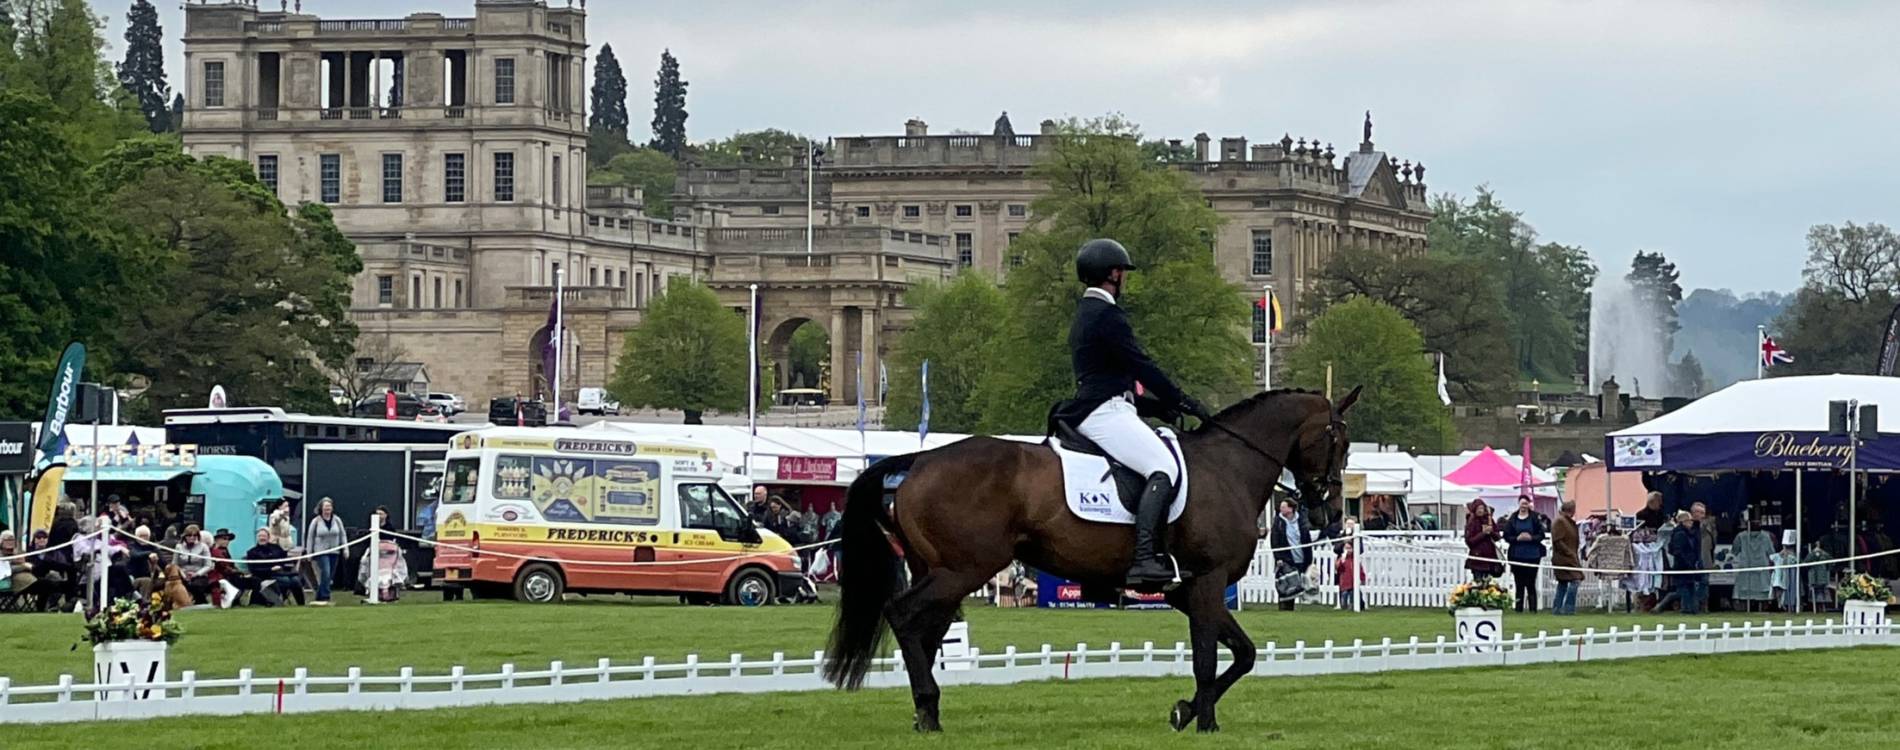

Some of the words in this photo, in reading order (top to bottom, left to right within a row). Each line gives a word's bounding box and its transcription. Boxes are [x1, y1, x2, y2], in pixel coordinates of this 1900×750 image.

[50, 362, 74, 436] Barbour
[64, 444, 198, 466] COFFEE
[557, 440, 633, 452] FREDERICK'S
[1754, 432, 1852, 468] Blueberry
[547, 528, 648, 543] FREDERICK'S
